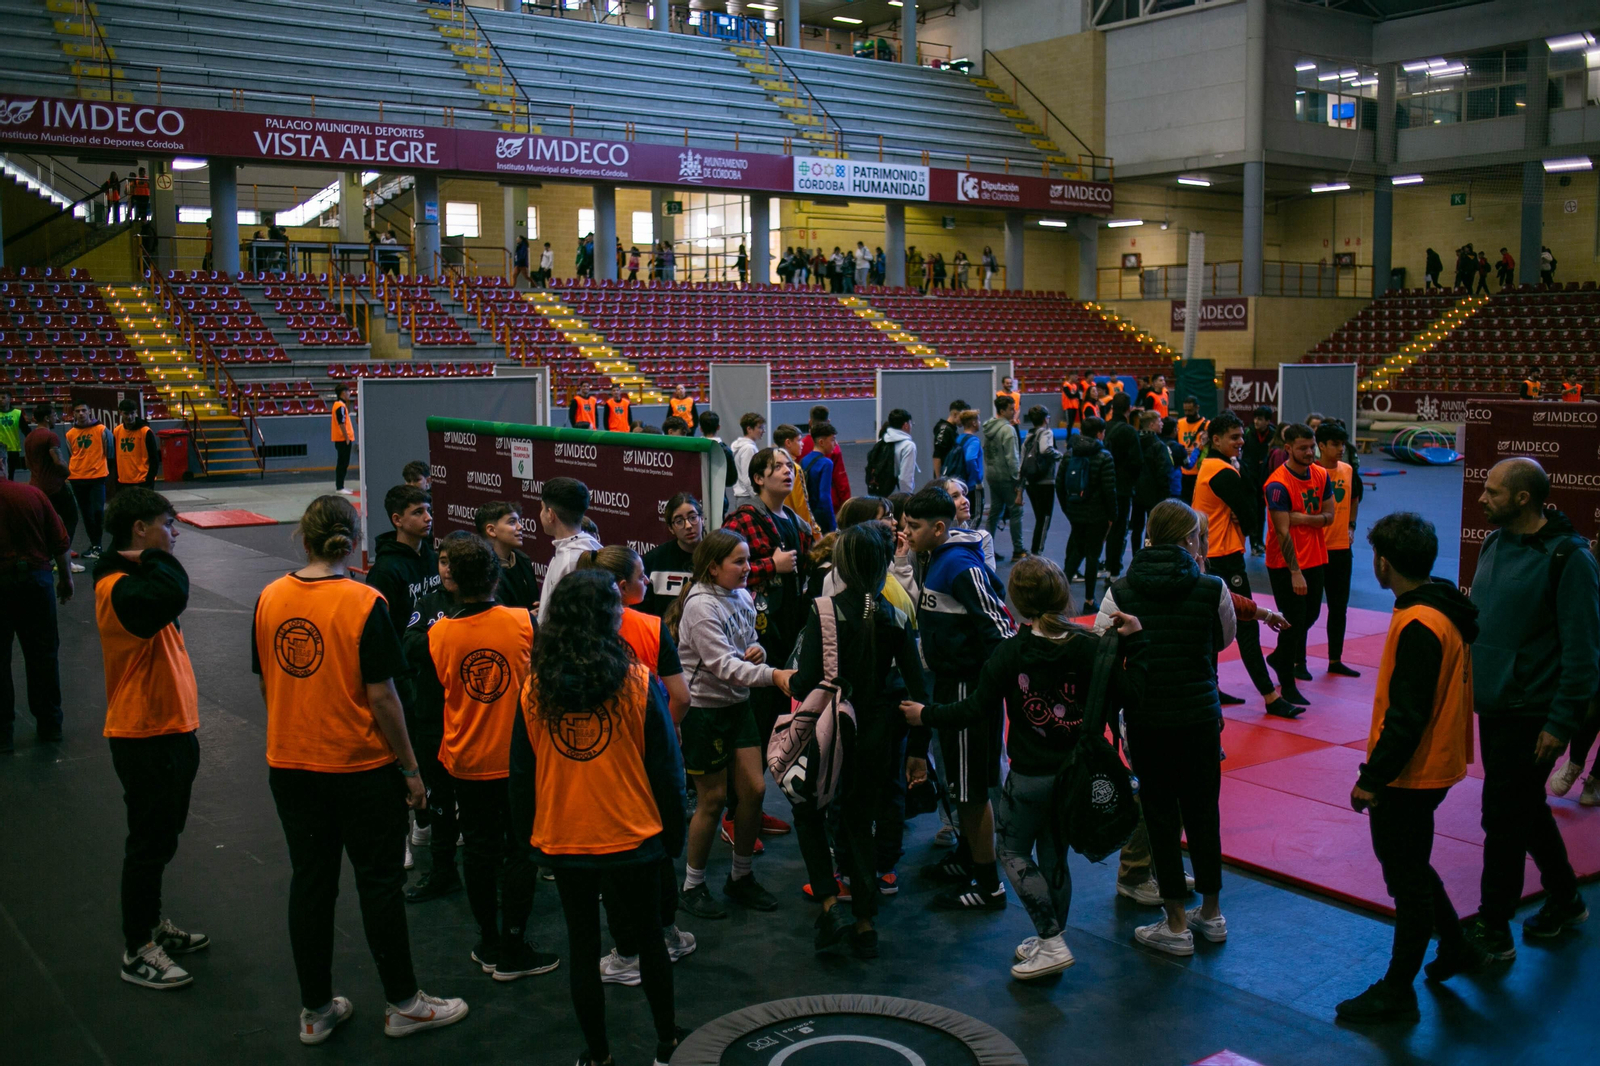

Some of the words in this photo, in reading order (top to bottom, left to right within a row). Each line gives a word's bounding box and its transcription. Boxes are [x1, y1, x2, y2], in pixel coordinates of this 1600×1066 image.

[42, 100, 185, 136] IMDECO
[265, 118, 313, 131] PALACIO
[315, 122, 372, 135] MUNICIPAL
[375, 126, 425, 139] DEPORTES
[0, 131, 38, 141] Instituto
[41, 133, 87, 145] Municipal
[89, 136, 101, 145] de
[103, 137, 145, 148] Deportes
[147, 139, 184, 150] Córdoba
[253, 131, 331, 159] VISTA
[339, 137, 440, 165] ALEGRE
[528, 137, 629, 166] IMDECO
[496, 162, 525, 172] Instituto
[526, 164, 559, 174] Municipal
[560, 166, 569, 174] de
[570, 166, 600, 177] Deportes
[601, 168, 629, 178] Córdoba
[703, 156, 749, 170] AYUNTAMIENTO
[703, 168, 711, 178] DE
[853, 166, 918, 182] PATRIMONIO
[798, 177, 845, 192] CÓRDOBA
[853, 179, 926, 197] HUMANIDAD
[981, 180, 1020, 192] Diputación
[1064, 184, 1112, 203] IMDECO
[1455, 195, 1462, 204] K
[1197, 304, 1246, 320] MDECO
[1547, 411, 1598, 423] IMDECO
[450, 431, 477, 446] IMDECO
[1511, 440, 1560, 453] IMDECO
[563, 443, 597, 460] IMDECO
[634, 450, 674, 468] IMDECO
[475, 471, 502, 487] IMDECO
[594, 490, 630, 508] IMDECO
